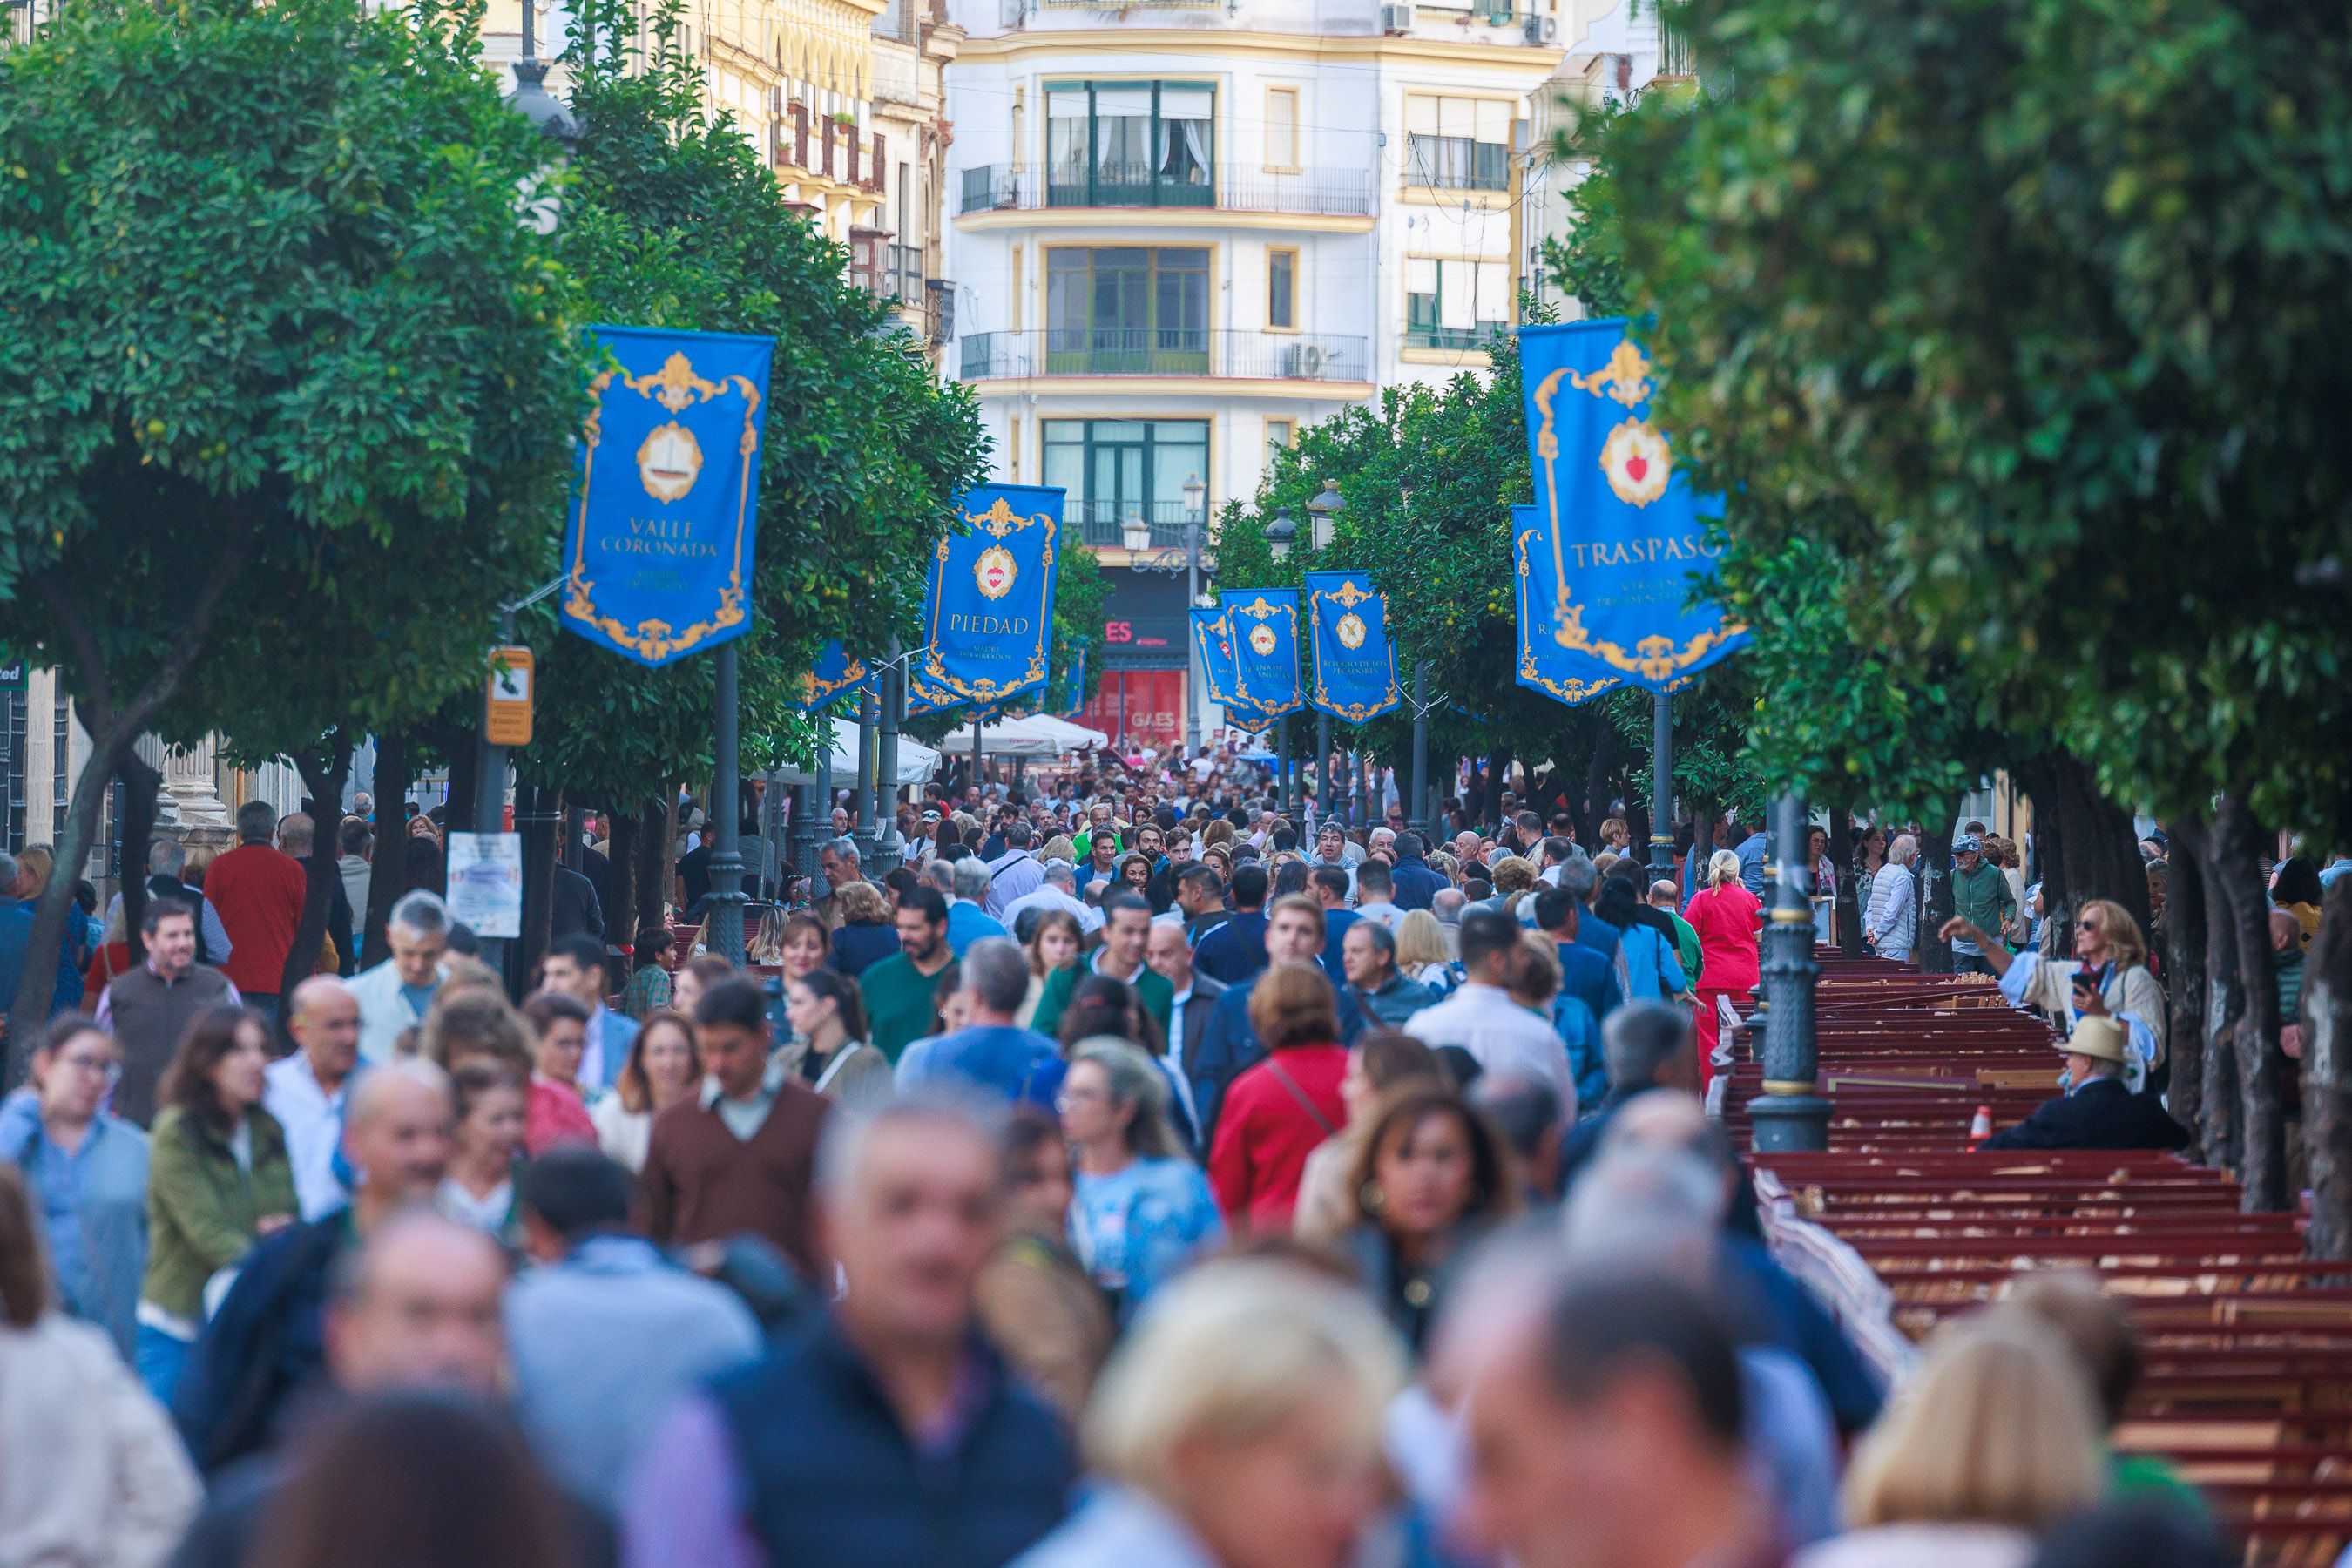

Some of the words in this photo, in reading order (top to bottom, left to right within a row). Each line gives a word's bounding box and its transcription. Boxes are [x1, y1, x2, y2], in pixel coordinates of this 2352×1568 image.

[601, 537, 717, 558] CORONADA
[950, 613, 1029, 634] PIEDAD
[1132, 711, 1175, 727] GAES
